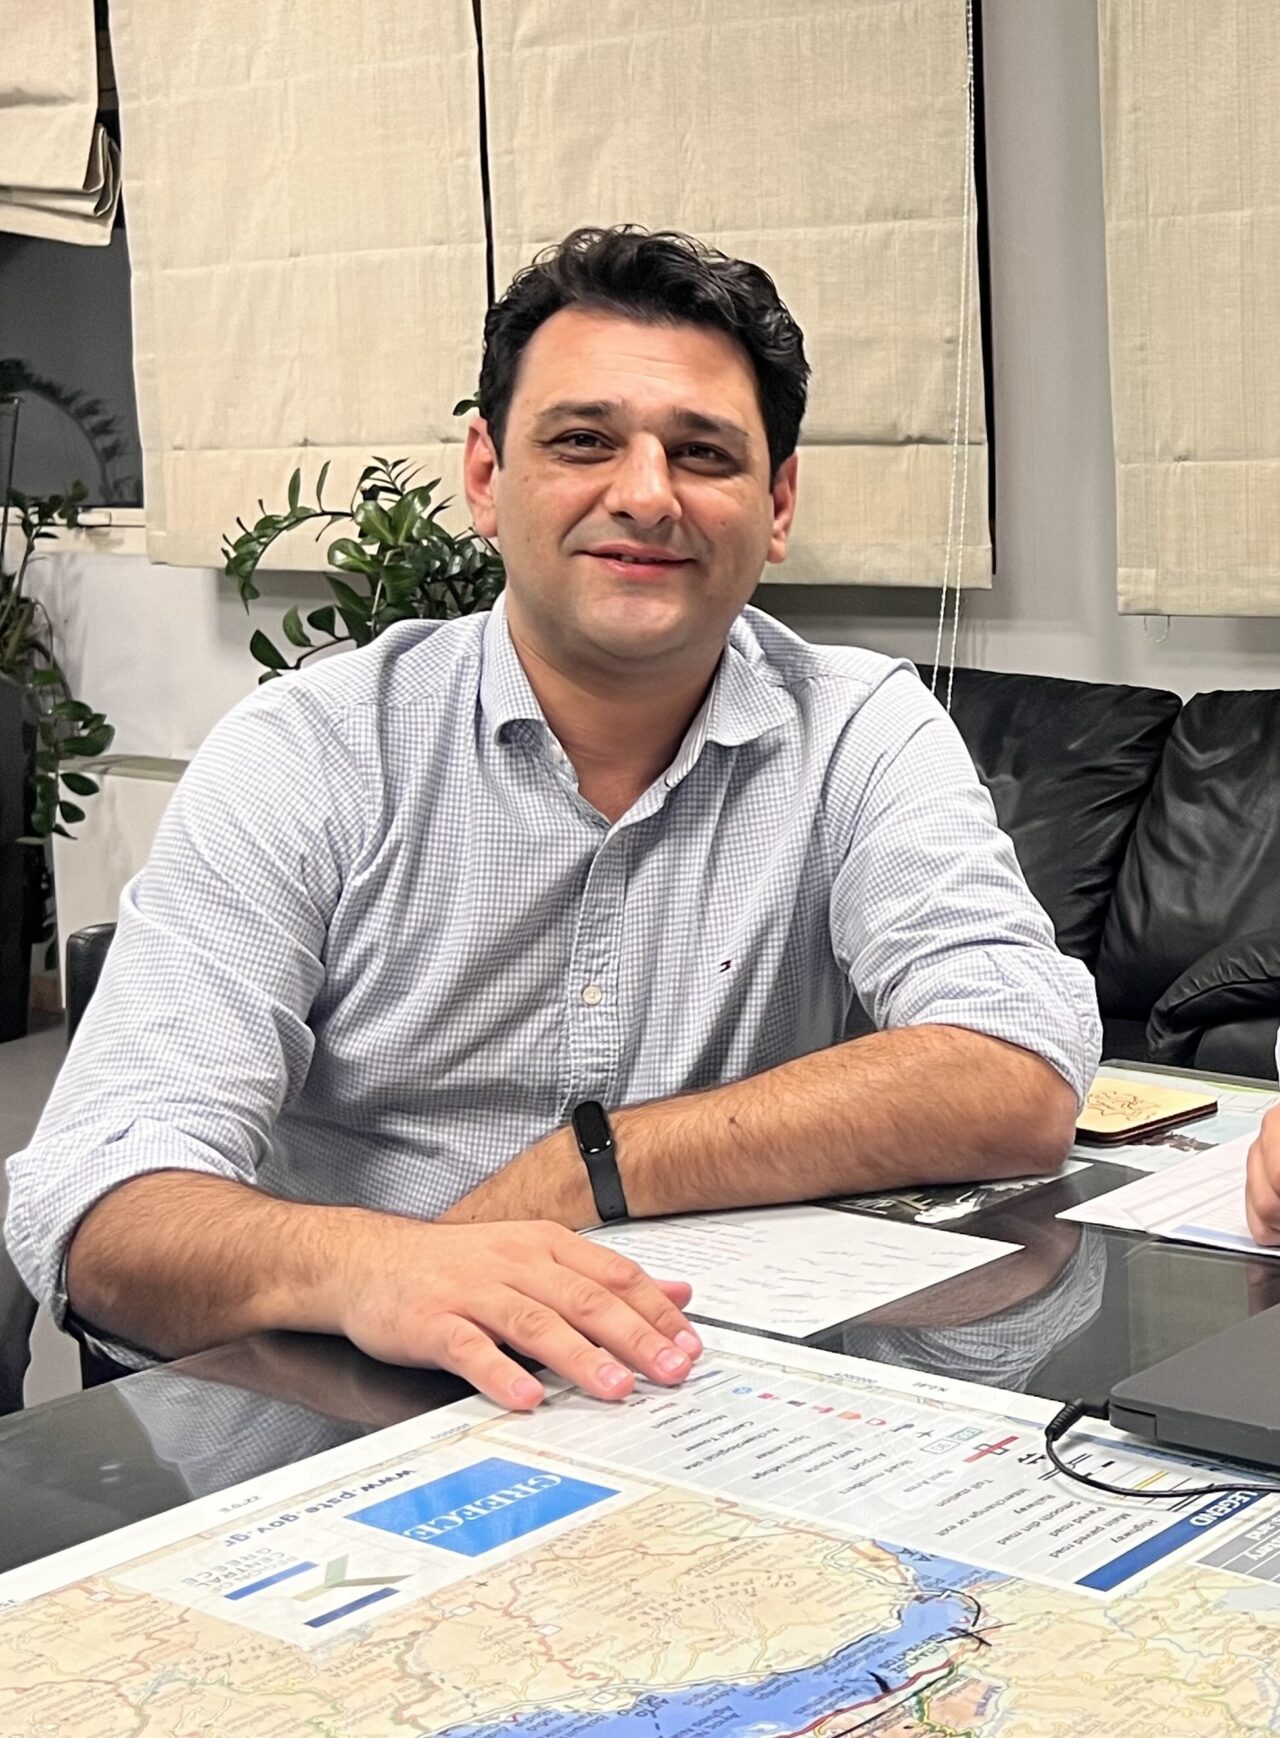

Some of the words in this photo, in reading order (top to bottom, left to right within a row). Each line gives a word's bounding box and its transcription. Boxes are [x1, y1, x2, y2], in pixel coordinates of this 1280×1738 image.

[666, 1414, 729, 1438] Monastery
[681, 1436, 721, 1451] Tower
[785, 1434, 812, 1444] Spa
[784, 1440, 839, 1463] Mountain
[829, 1446, 863, 1460] Ferry
[681, 1460, 709, 1470] site
[801, 1459, 836, 1473] route
[845, 1452, 890, 1471] Airport
[881, 1459, 915, 1473] Road
[747, 1463, 790, 1480] refuge
[836, 1471, 889, 1495] numbers
[968, 1478, 993, 1489] Toll
[398, 1471, 570, 1540] GREECE
[933, 1488, 974, 1507] station
[965, 1487, 1030, 1518] Interchange
[1010, 1493, 1056, 1514] Railway
[213, 1468, 418, 1547] www.pste.gov.gr
[1037, 1499, 1082, 1521] Smooth
[1070, 1506, 1107, 1523] Paved
[1185, 1488, 1259, 1527] LEGEND
[1018, 1520, 1044, 1532] dirt
[1102, 1512, 1133, 1527] Main
[933, 1524, 961, 1536] exit
[994, 1530, 1026, 1545] road
[1047, 1523, 1076, 1536] road
[1069, 1526, 1108, 1544] paved
[1107, 1518, 1159, 1543] Highway
[1046, 1543, 1077, 1558] road
[178, 1546, 276, 1585] GREECE
[192, 1551, 288, 1589] CENTRAL
[232, 1555, 300, 1582] REGION
[206, 1581, 238, 1593] OF
